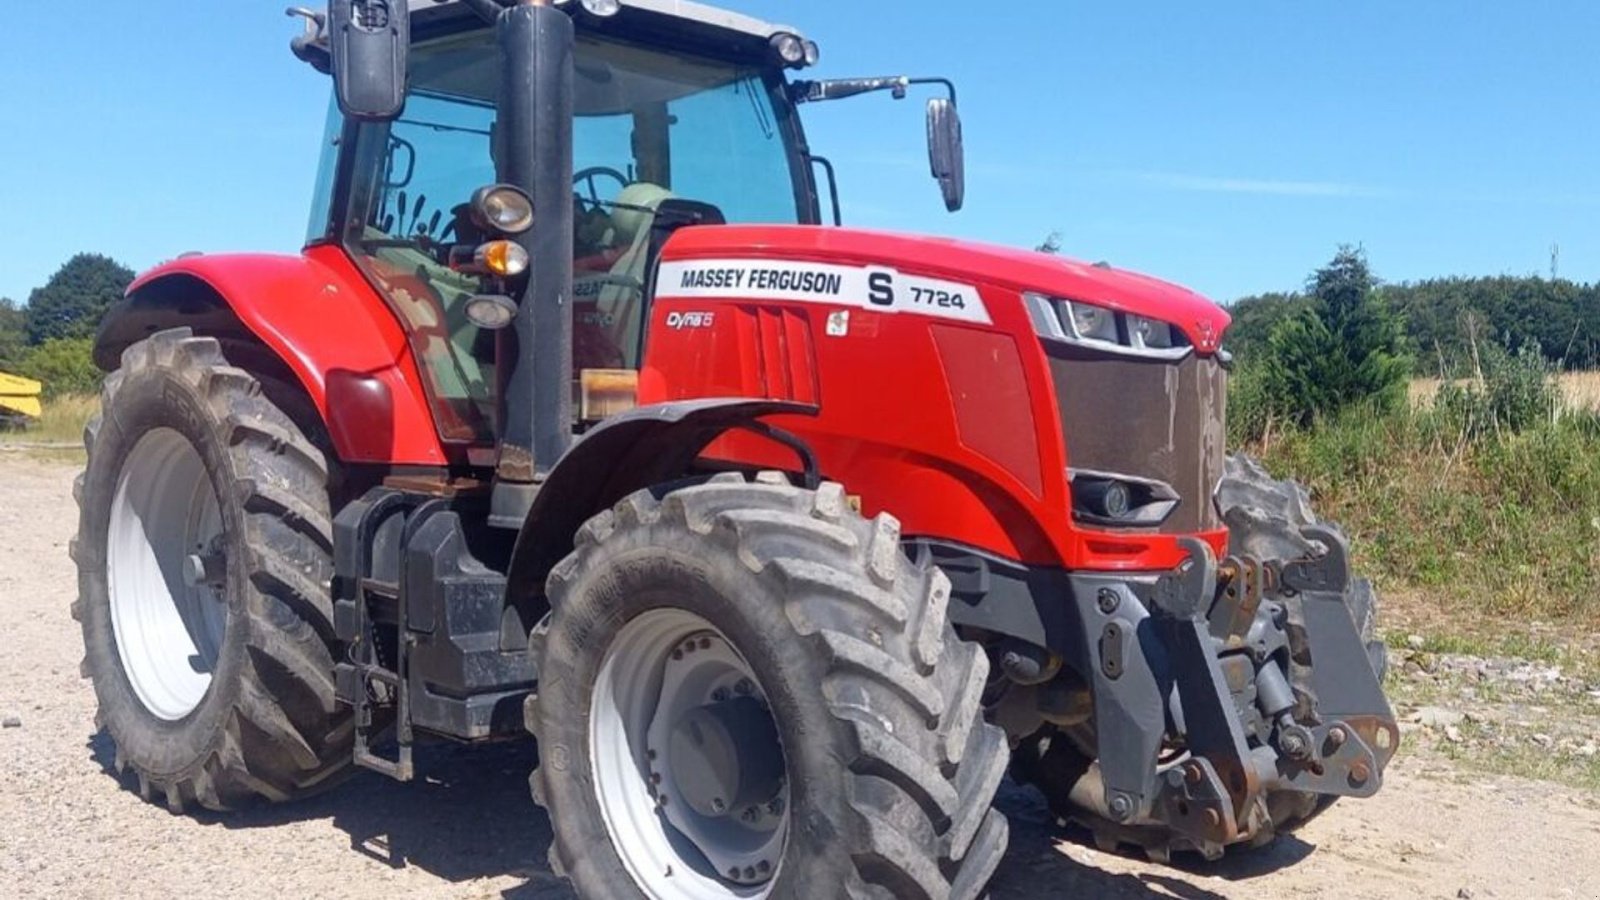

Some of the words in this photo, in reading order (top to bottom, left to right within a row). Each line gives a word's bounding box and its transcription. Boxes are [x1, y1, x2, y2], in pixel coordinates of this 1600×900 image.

[680, 268, 745, 289] MASSEY
[747, 268, 842, 295] FERGUSON
[868, 271, 894, 306] S
[909, 286, 966, 310] 7724
